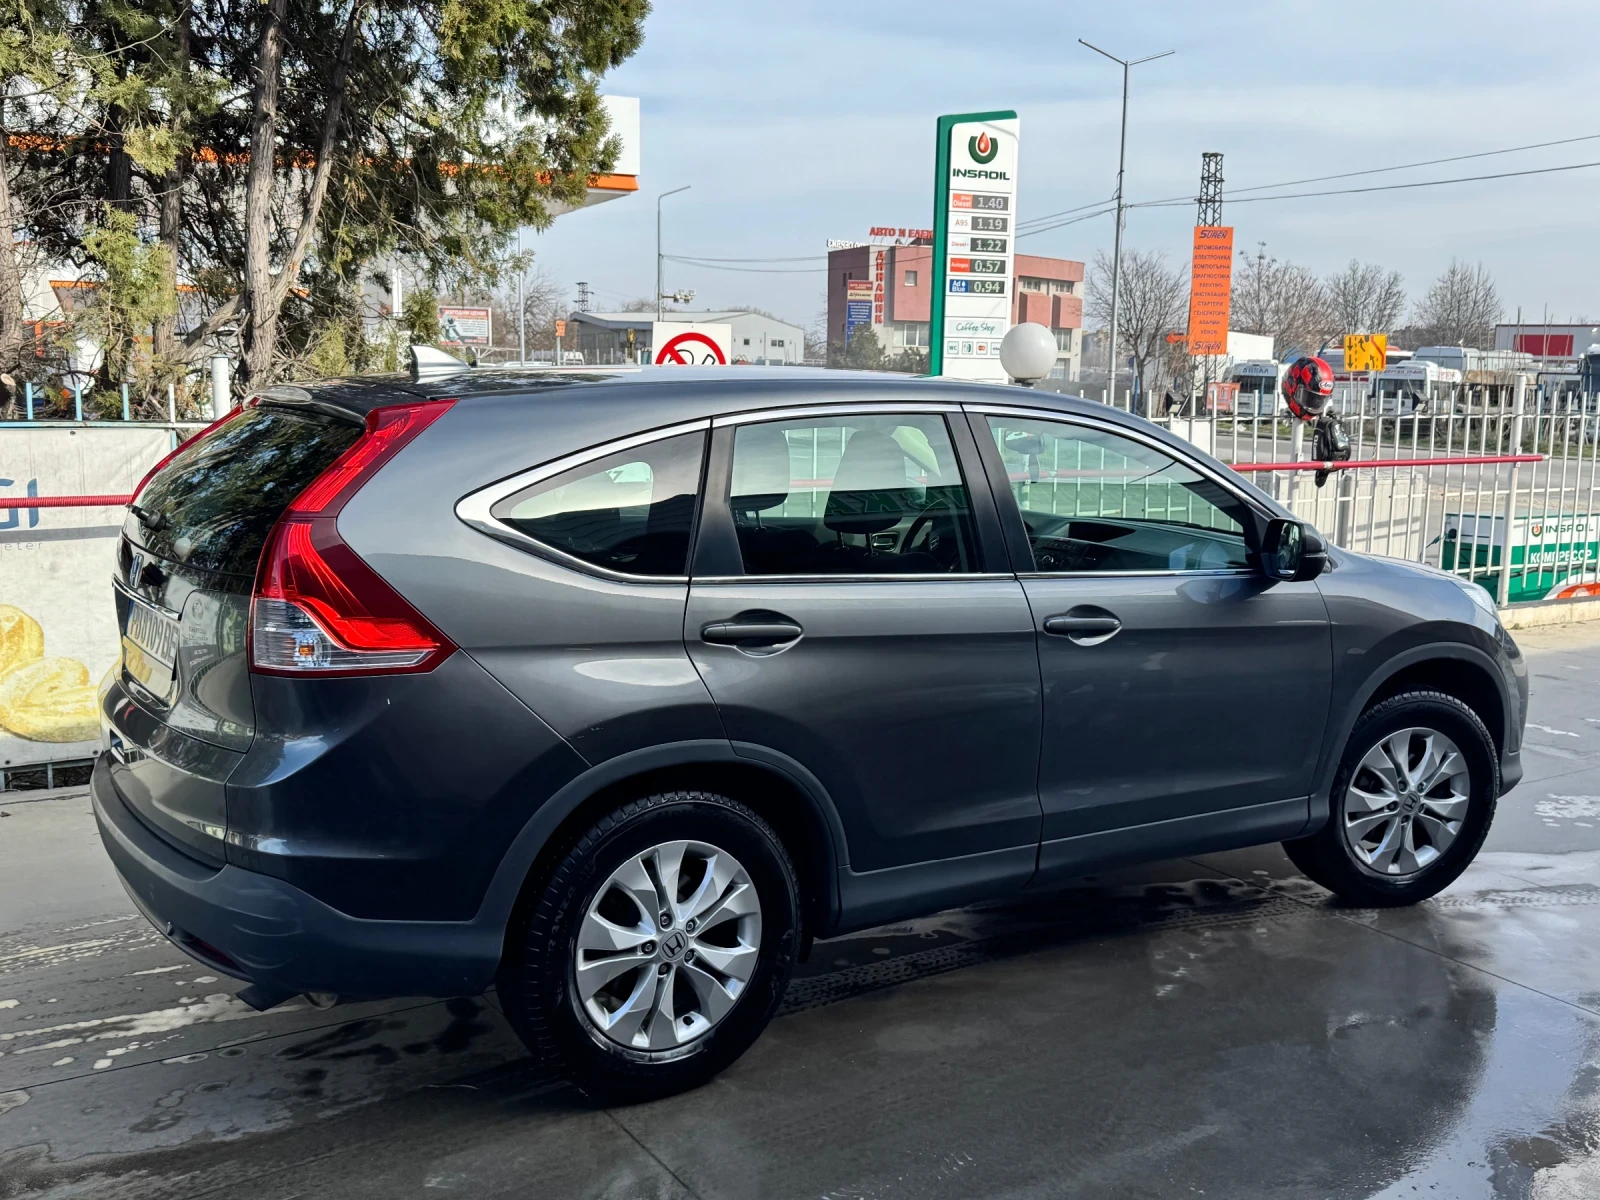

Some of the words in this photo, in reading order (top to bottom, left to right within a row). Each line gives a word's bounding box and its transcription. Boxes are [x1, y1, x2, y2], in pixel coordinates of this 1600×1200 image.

[952, 168, 1010, 180] INSAOIL
[953, 200, 972, 208] Diesel
[977, 197, 1003, 209] 1.40
[976, 217, 1003, 230] 1.19
[869, 227, 896, 236] АВТО
[1199, 229, 1228, 239] SUREN
[975, 239, 1002, 252] 1.22
[974, 260, 1001, 273] 0.57
[974, 281, 1000, 293] 0.94
[956, 322, 979, 331] Coffee
